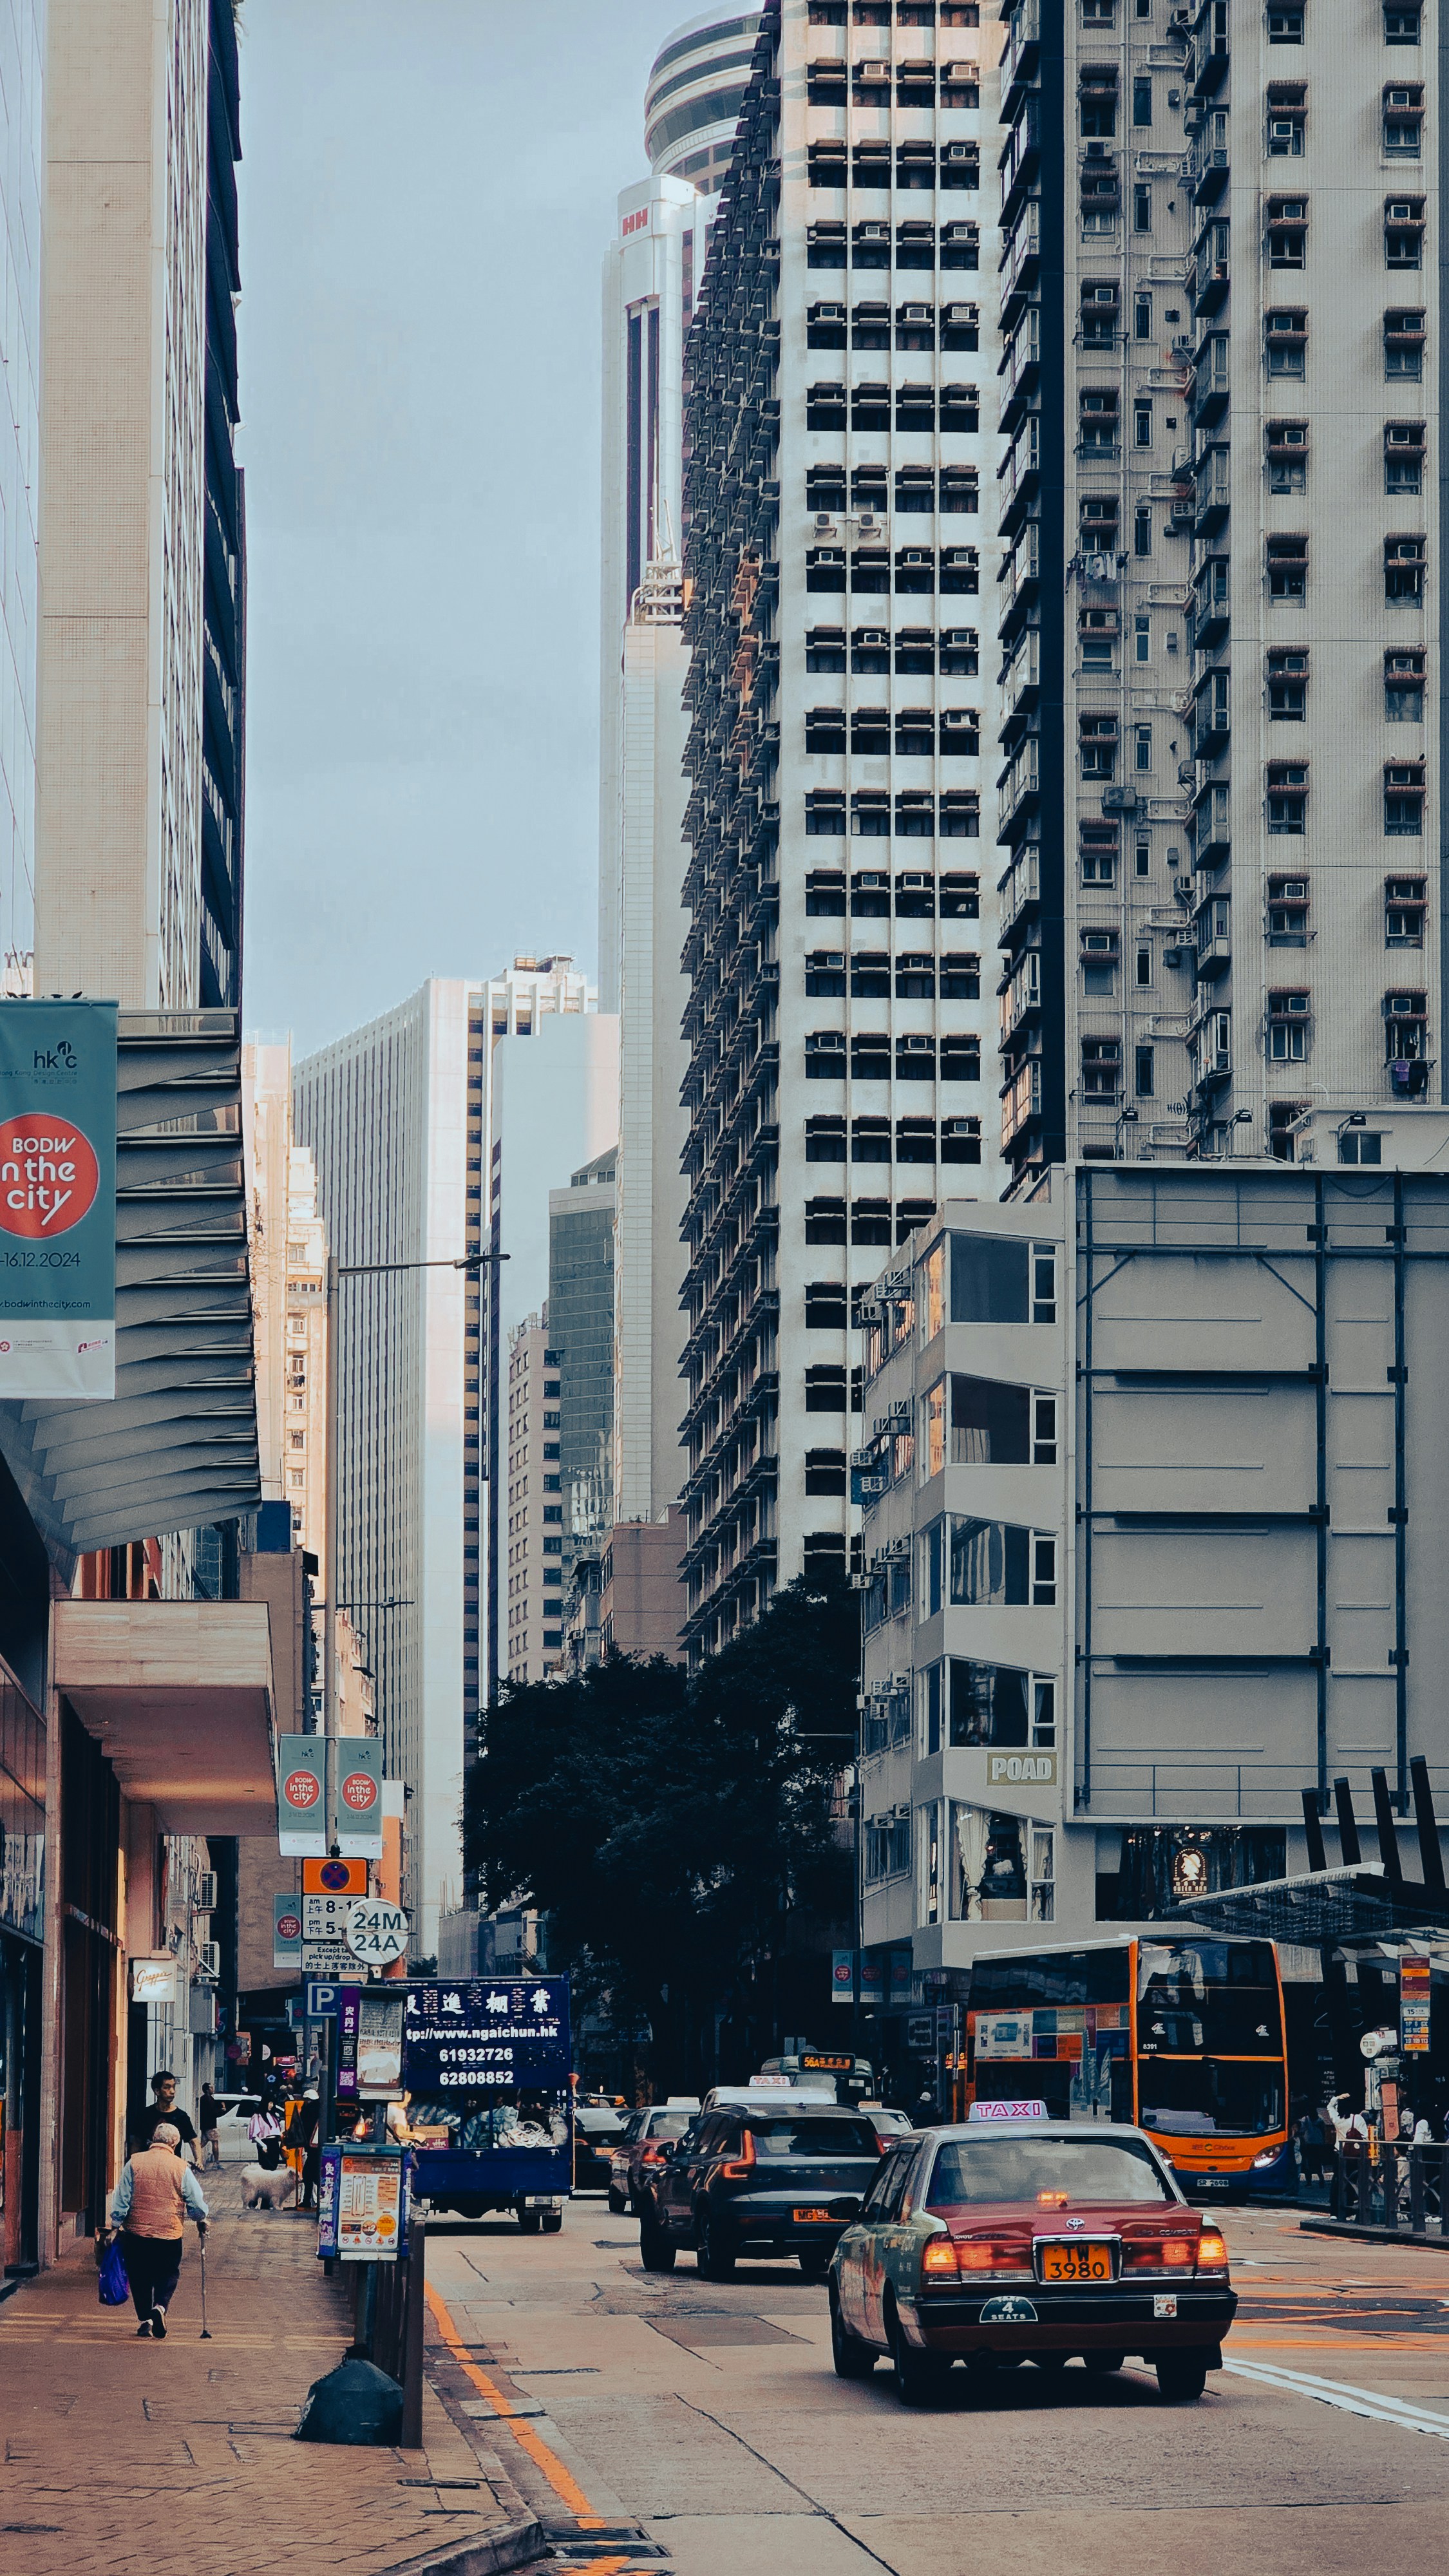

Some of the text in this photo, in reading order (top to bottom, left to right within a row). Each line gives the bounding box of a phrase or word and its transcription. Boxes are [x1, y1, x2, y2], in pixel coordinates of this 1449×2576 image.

[622, 207, 648, 237] HH
[12, 1137, 76, 1153] BODW
[24, 1155, 76, 1182] the
[7, 1184, 72, 1226] city
[992, 1757, 1052, 1781] POAD
[290, 1783, 314, 1792] in the
[347, 1785, 371, 1794] in the
[293, 1792, 313, 1805] city
[350, 1794, 370, 1807] city
[307, 1906, 323, 1914] 上午
[354, 1913, 401, 1930] 24M
[308, 1927, 323, 1935] 下午
[355, 1935, 400, 1951] 24A
[305, 1962, 365, 1971] 的士上落客除外
[316, 1988, 334, 2011] P
[439, 2048, 513, 2062] 61932726
[439, 2071, 513, 2085] 62808852
[976, 2103, 1040, 2117] TAXI
[1065, 2246, 1089, 2262] TW
[1050, 2262, 1104, 2278] 3980
[1002, 2302, 1014, 2313] 4
